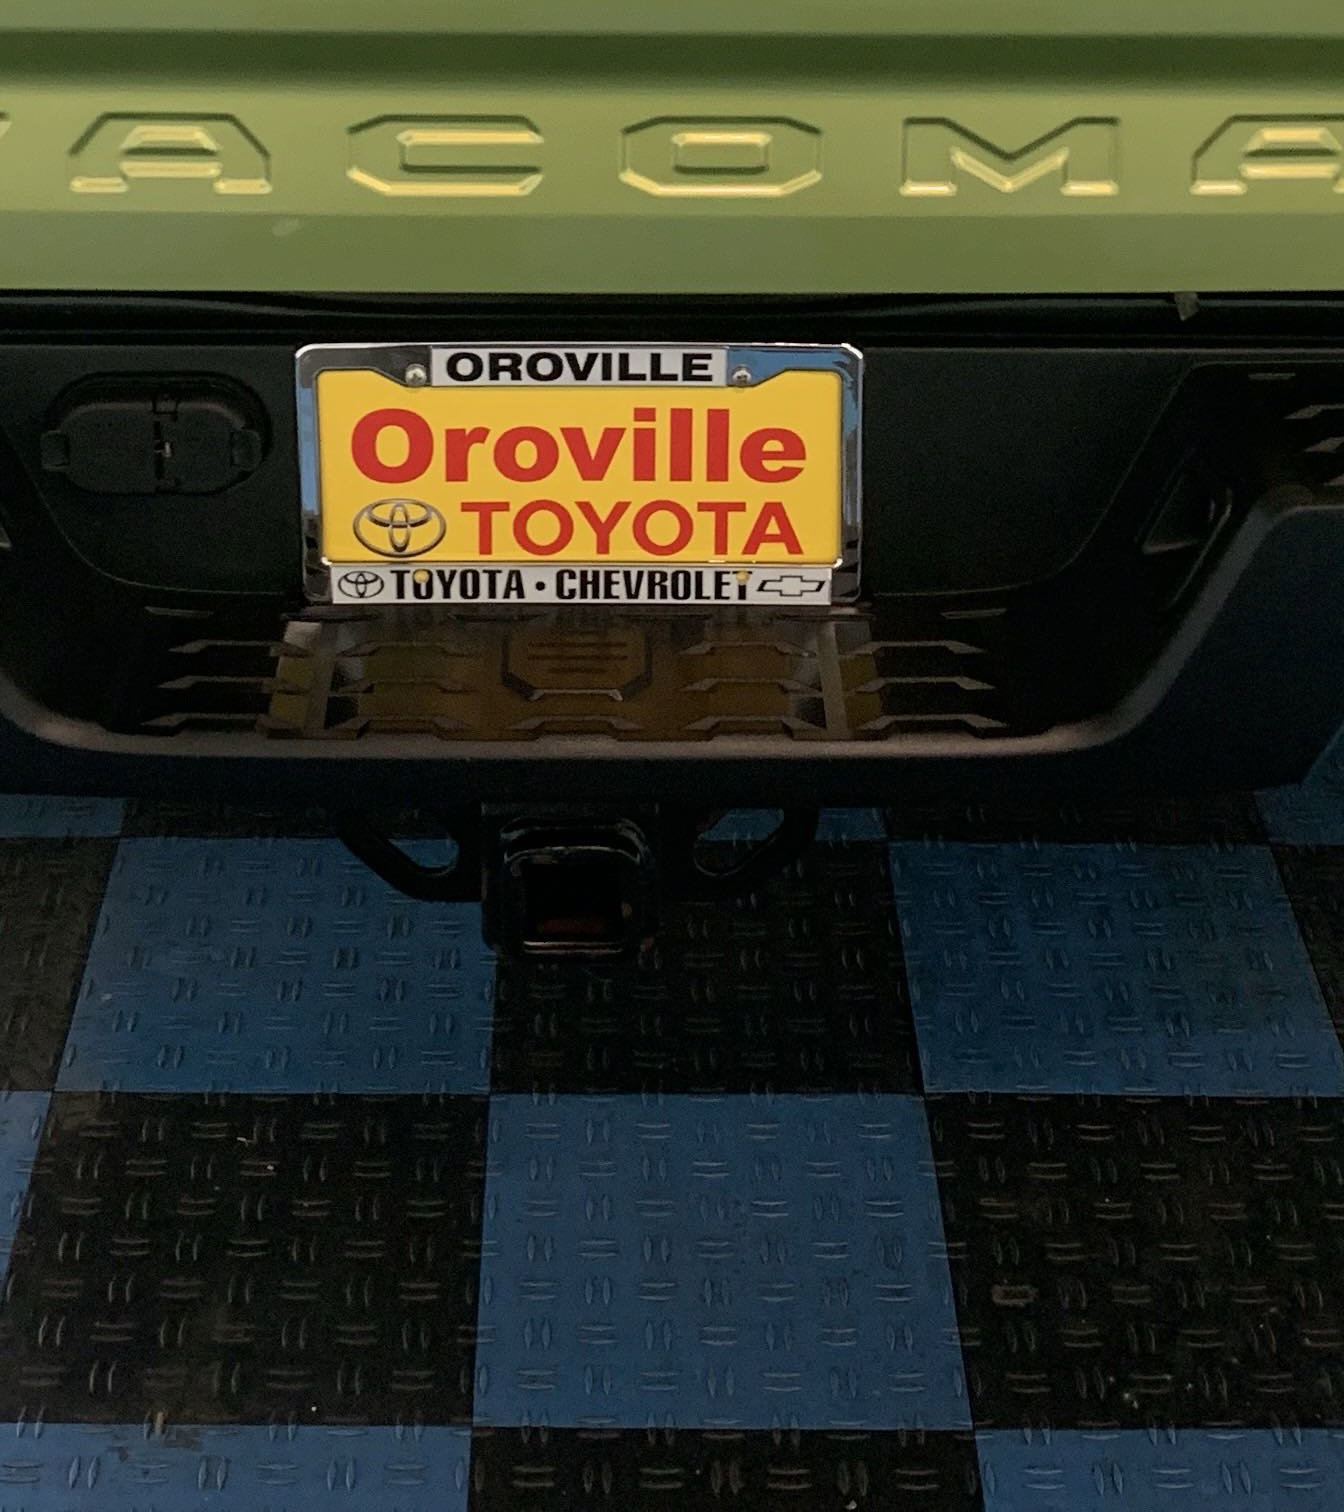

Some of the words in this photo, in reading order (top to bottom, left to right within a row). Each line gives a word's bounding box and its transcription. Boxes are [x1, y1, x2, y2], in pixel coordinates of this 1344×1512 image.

[447, 351, 713, 383] OROVILLE
[351, 407, 807, 484] Oroville
[461, 499, 803, 556] TOYOTA
[392, 569, 523, 601] TOYOTA
[555, 568, 753, 601] CHEVROLET
